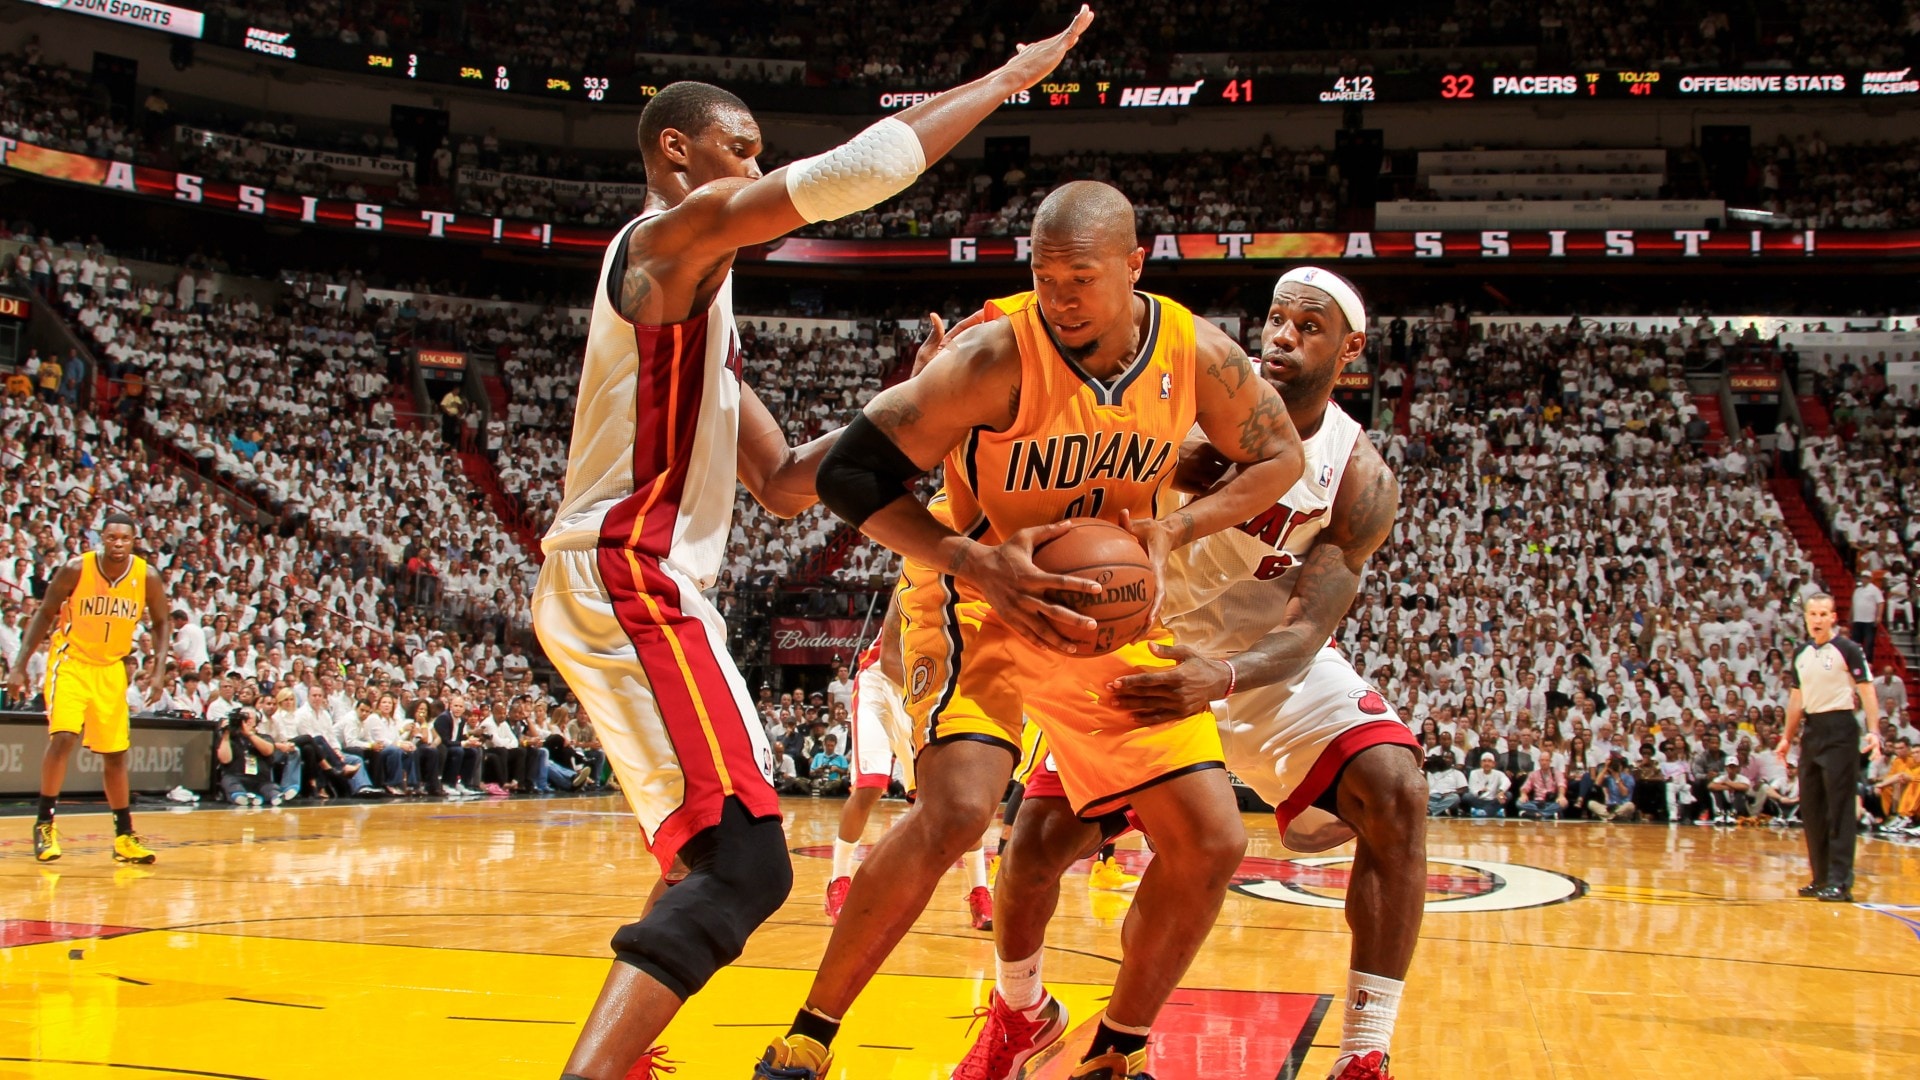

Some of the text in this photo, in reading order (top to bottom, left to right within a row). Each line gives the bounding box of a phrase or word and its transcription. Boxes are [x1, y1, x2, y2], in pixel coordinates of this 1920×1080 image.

[109, 0, 172, 26] SPORTS
[246, 27, 290, 44] HEAT
[245, 38, 296, 58] PACERS
[368, 55, 392, 68] 3PM
[408, 54, 417, 66] 3
[407, 67, 416, 78] 4
[460, 67, 482, 79] 3PA
[497, 66, 506, 78] 9
[1585, 73, 1599, 83] TF
[1863, 68, 1911, 82] HEAT
[495, 78, 509, 90] 10
[547, 79, 570, 91] 3P%
[584, 77, 609, 89] 33.3
[1097, 82, 1110, 92] TF
[1334, 76, 1373, 92] 4:12
[1441, 75, 1474, 98] 32
[1493, 77, 1577, 95] PACERS
[1588, 83, 1596, 95] 1
[1629, 83, 1651, 95] 4/1
[1679, 76, 1845, 92] OFFENSIVE STATS
[1861, 80, 1919, 94] PACERS
[588, 89, 604, 101] 40
[1119, 80, 1204, 107] HEAT
[1222, 80, 1252, 102] 41
[1319, 91, 1375, 102] QUARTER 2
[1050, 93, 1069, 106] 5/1
[1098, 93, 1106, 104] 1
[1335, 377, 1369, 385] CARDI
[1004, 431, 1174, 492] INDIANA
[1253, 553, 1294, 581] 6
[79, 596, 138, 620] INDIANA
[103, 621, 110, 643] 1
[76, 746, 183, 773] GAORADE
